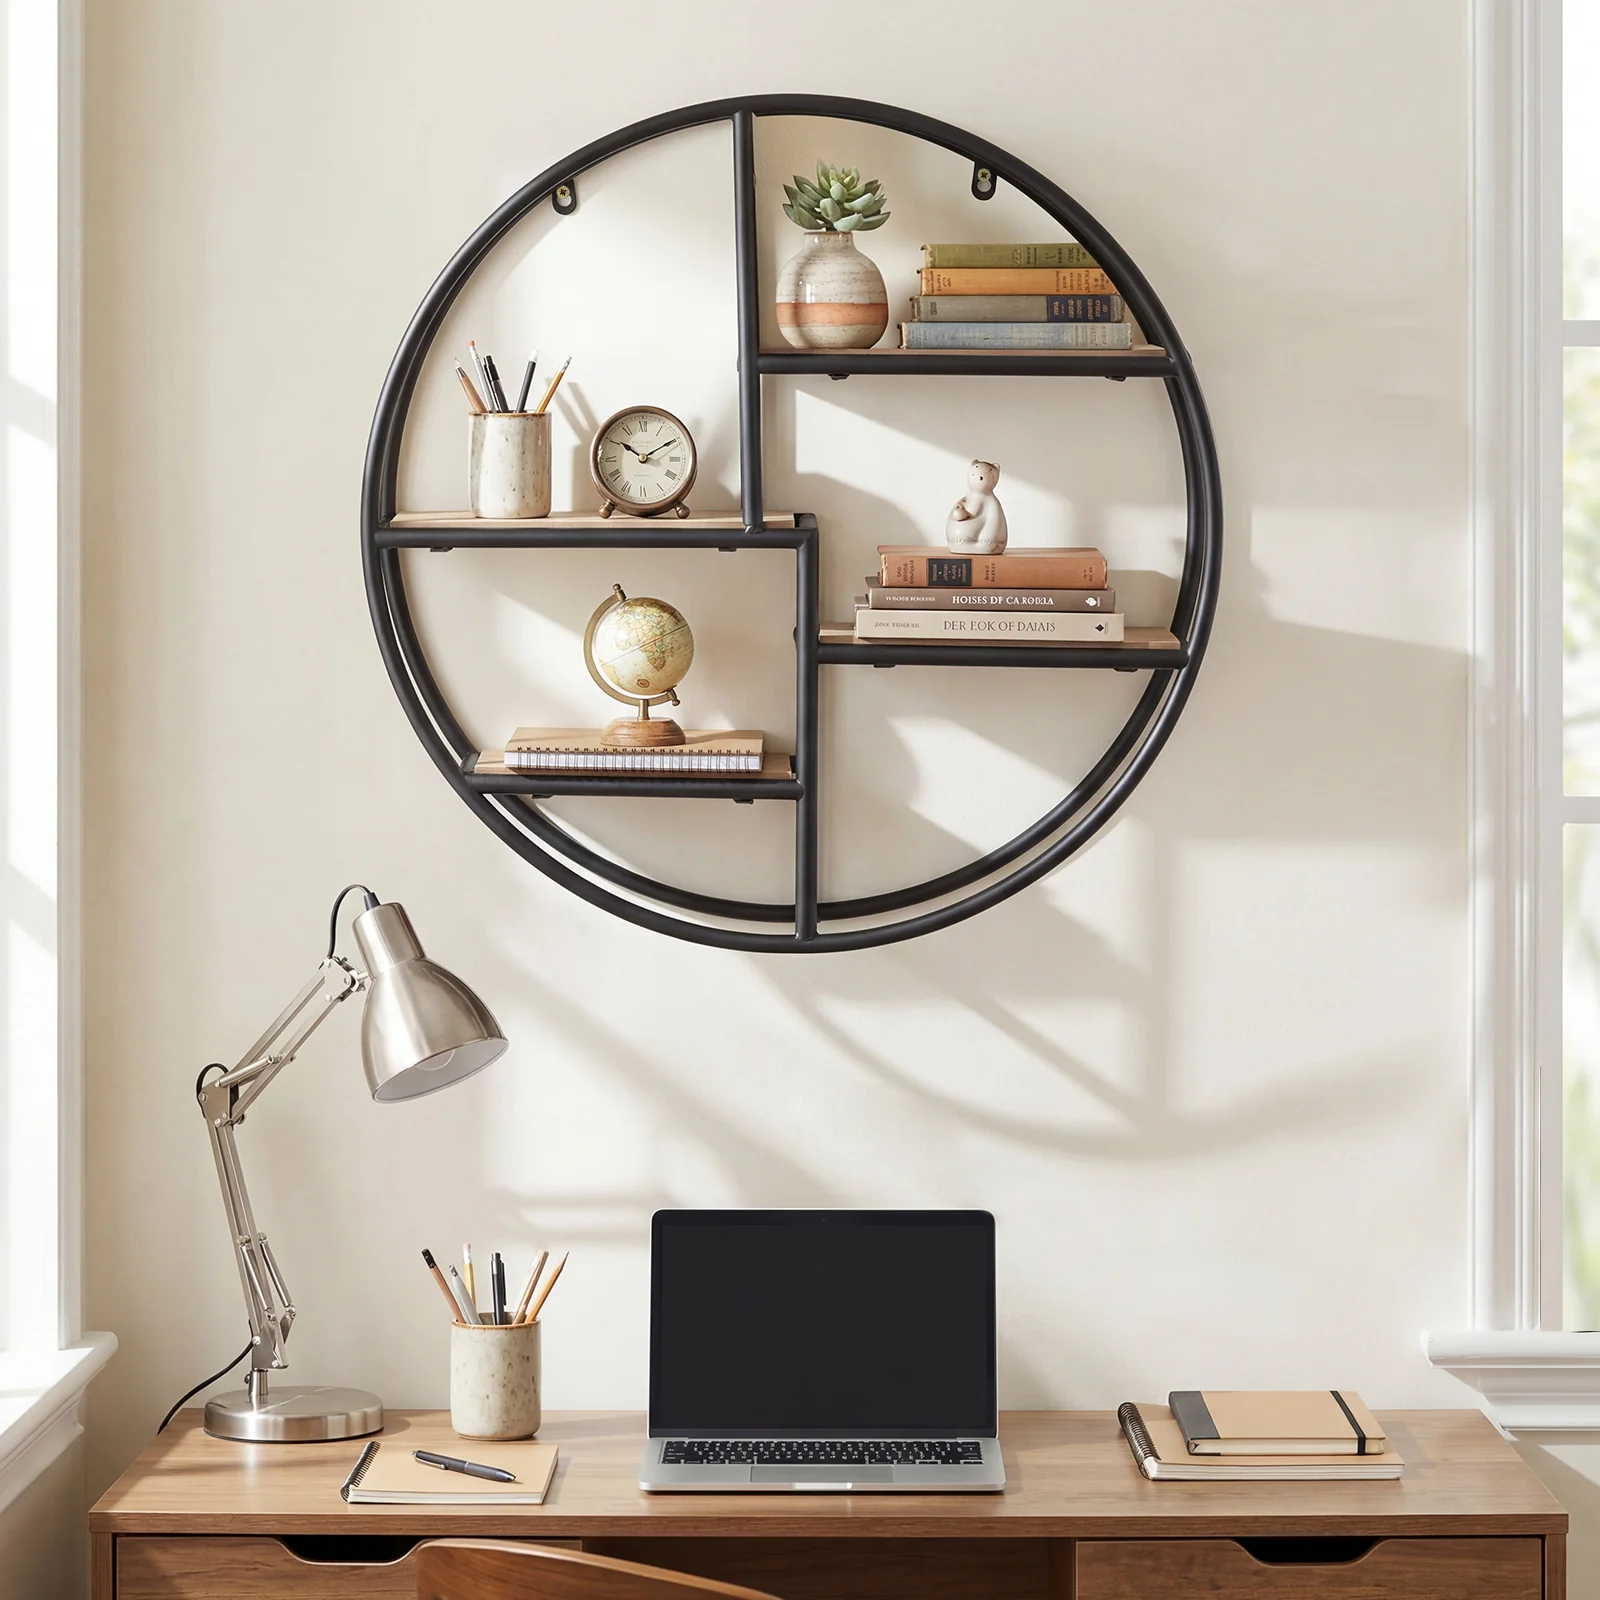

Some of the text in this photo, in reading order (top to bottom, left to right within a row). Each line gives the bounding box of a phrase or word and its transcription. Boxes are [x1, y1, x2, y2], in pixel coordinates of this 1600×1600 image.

[952, 595, 988, 605] HOISES
[944, 620, 966, 631] DER
[998, 621, 1015, 632] OF
